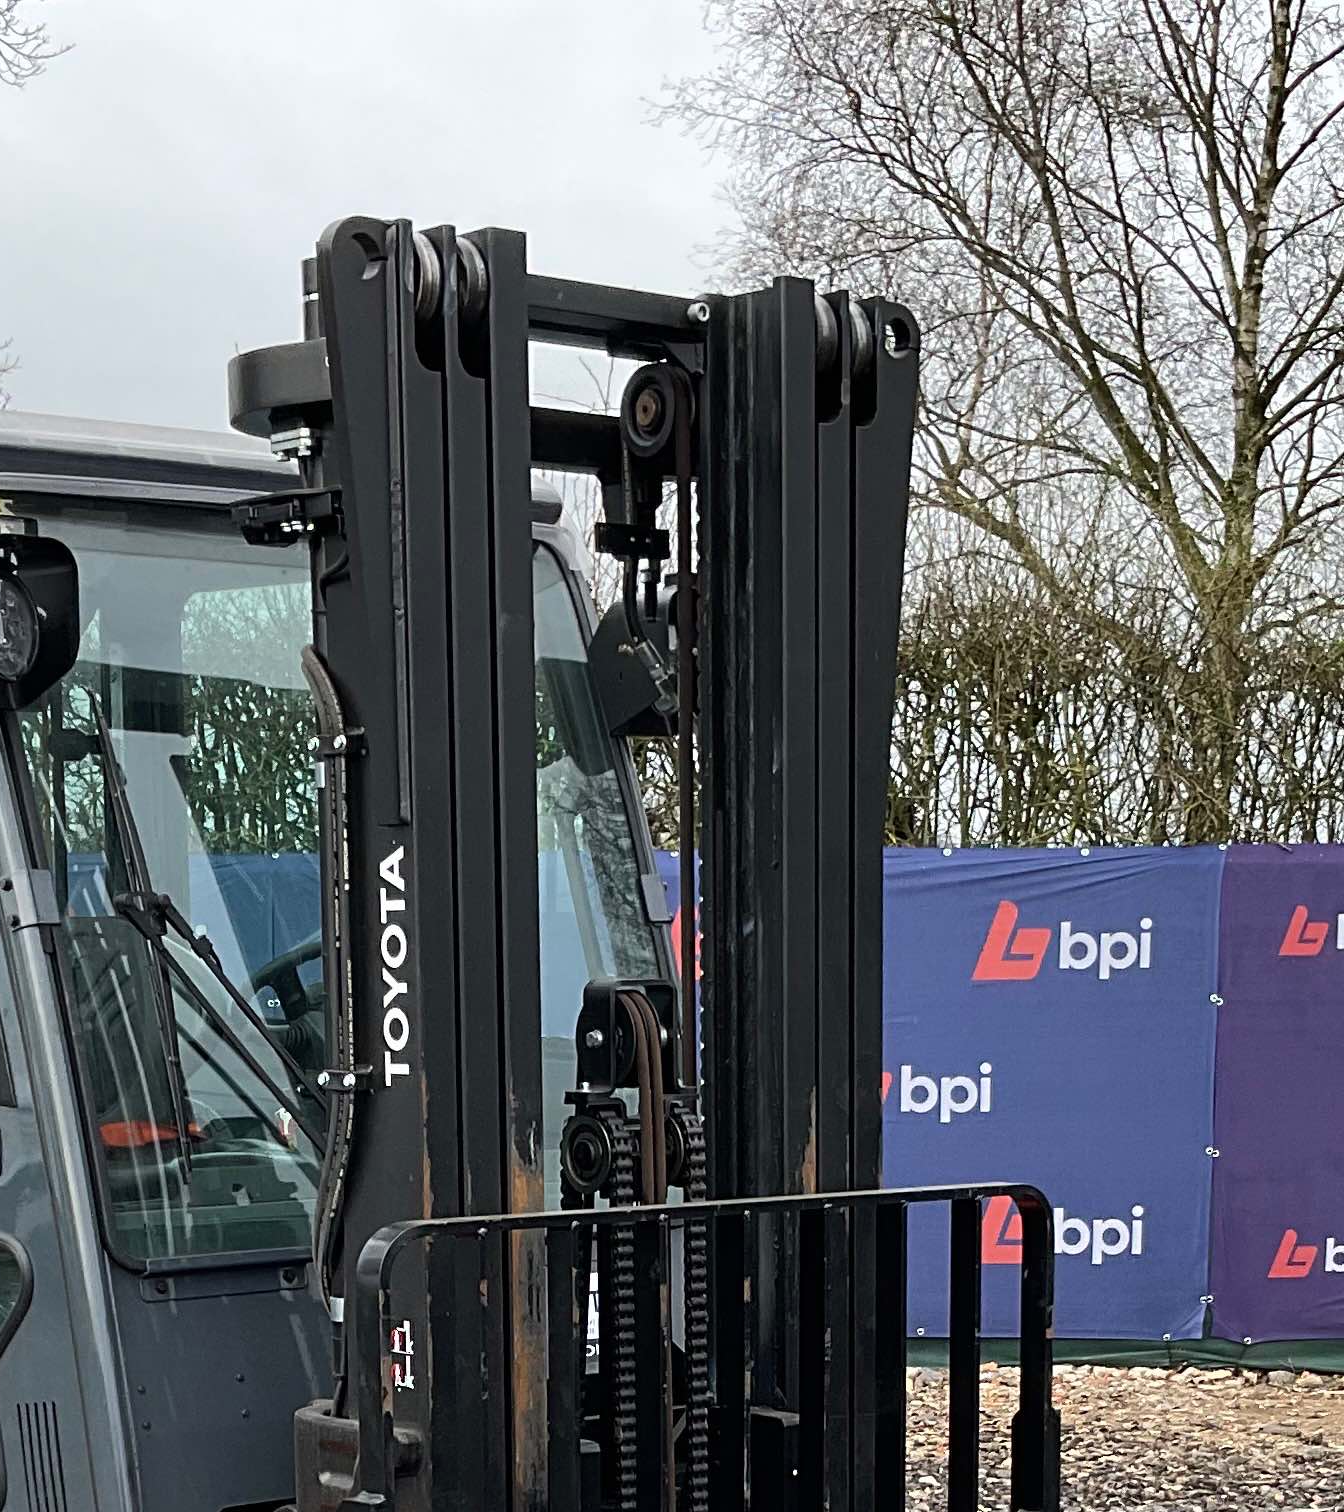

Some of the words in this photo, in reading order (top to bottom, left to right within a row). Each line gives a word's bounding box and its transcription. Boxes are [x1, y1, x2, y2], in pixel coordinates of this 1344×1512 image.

[380, 845, 410, 1087] TOYOTA
[1059, 917, 1153, 980] bpi
[900, 1062, 993, 1123] bpi
[1053, 1205, 1144, 1265] bpi
